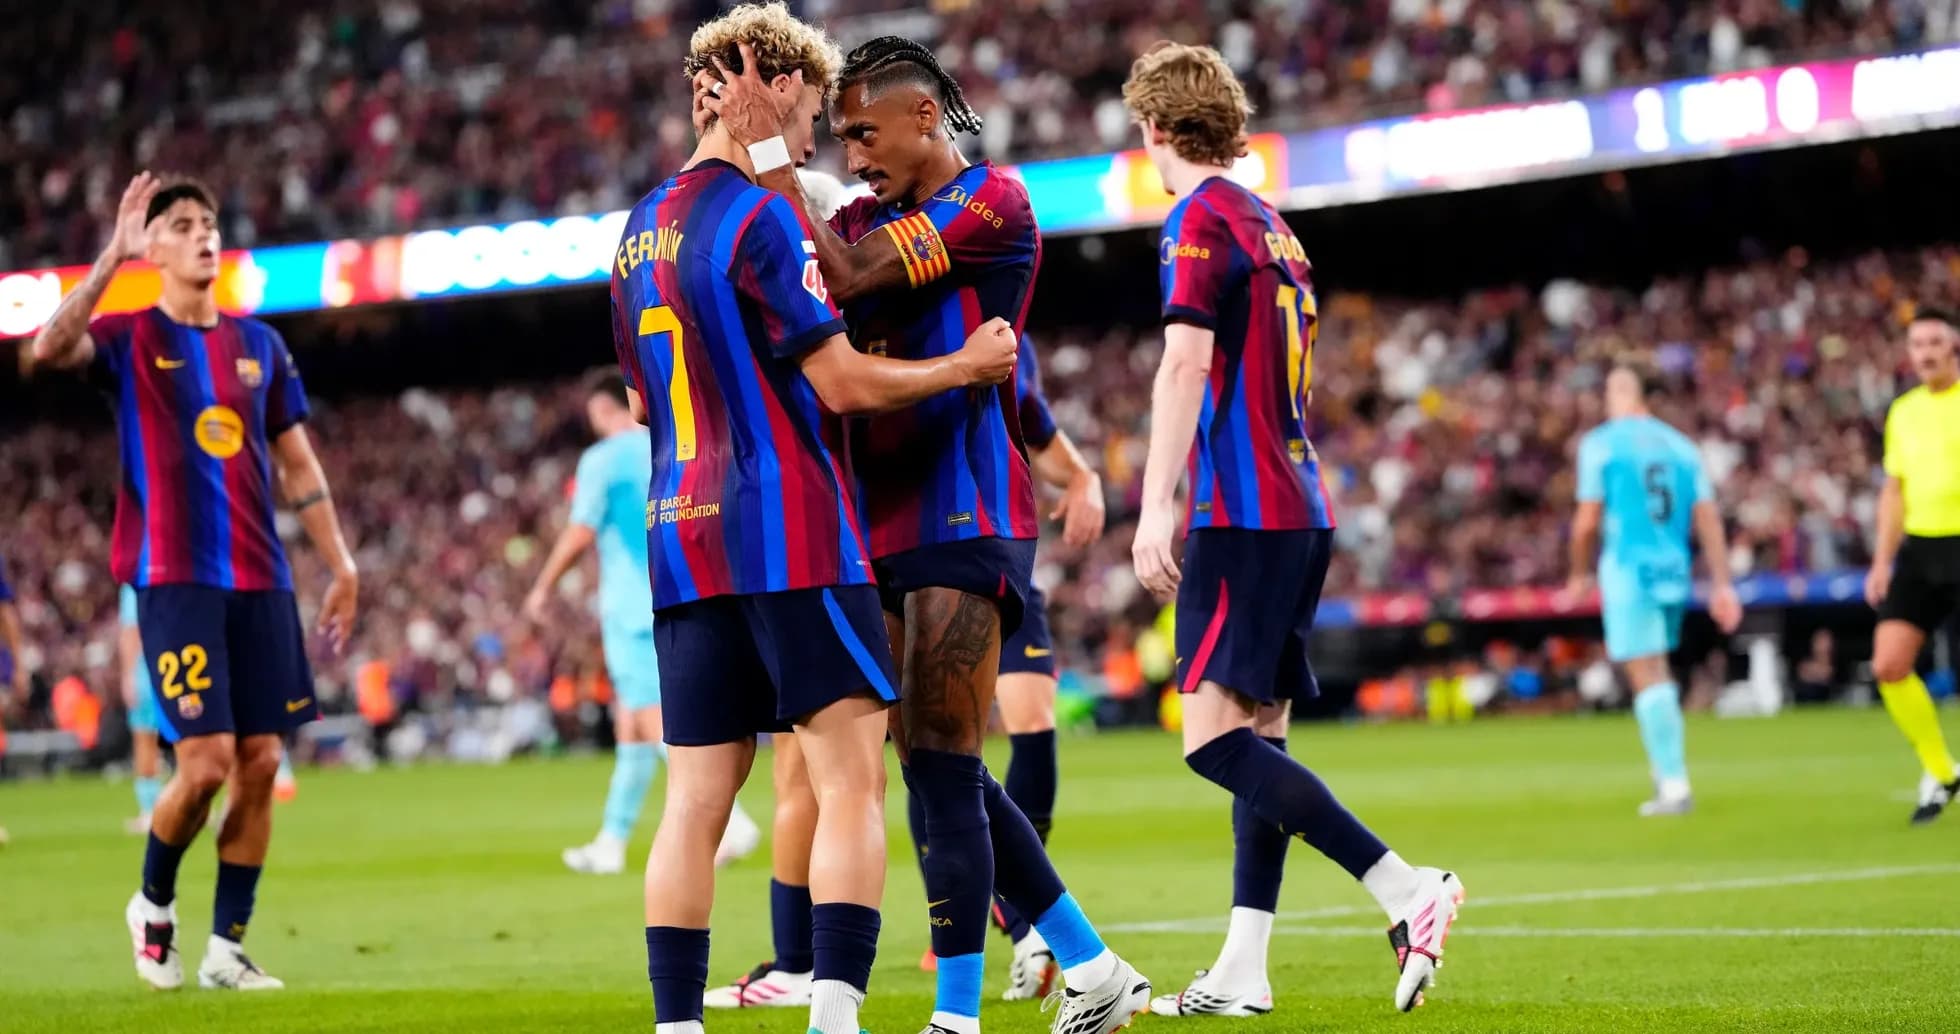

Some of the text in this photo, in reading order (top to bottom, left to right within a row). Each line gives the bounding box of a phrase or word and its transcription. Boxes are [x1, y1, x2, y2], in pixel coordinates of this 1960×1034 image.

[946, 187, 1003, 228] Midea
[617, 219, 684, 280] FERMÍN
[639, 305, 696, 461] 7
[660, 494, 692, 511] BARÇA
[660, 503, 720, 525] FOUNDATION
[1645, 461, 1673, 525] 5
[157, 643, 213, 700] 22
